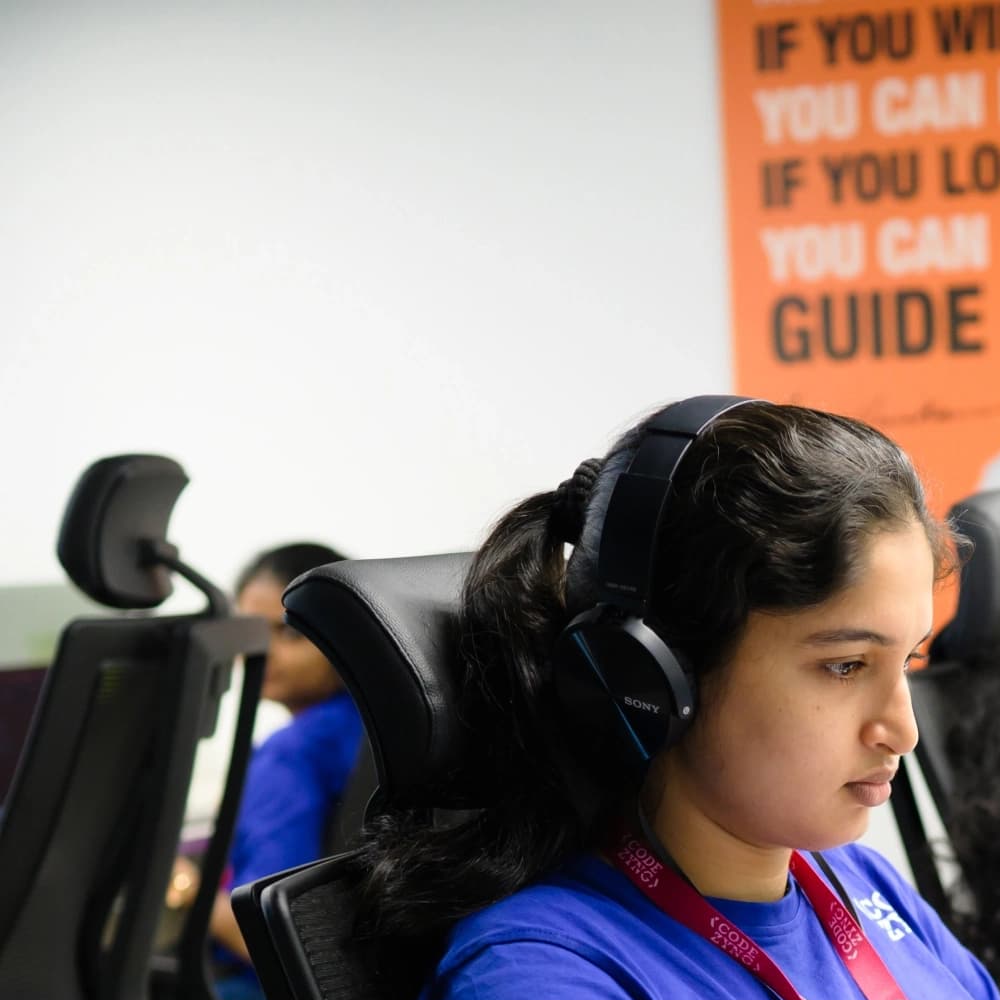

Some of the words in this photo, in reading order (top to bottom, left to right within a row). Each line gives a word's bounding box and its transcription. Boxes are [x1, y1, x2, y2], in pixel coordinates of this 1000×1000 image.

[756, 20, 799, 71] IF
[816, 13, 914, 66] YOU
[753, 81, 859, 143] YOU
[873, 71, 984, 136] CAN
[761, 159, 805, 208] IF
[821, 149, 918, 203] YOU
[761, 223, 862, 283] YOU
[878, 215, 989, 275] CAN
[771, 286, 984, 363] GUIDE
[624, 697, 660, 714] SONY
[629, 840, 663, 873] CODE
[719, 923, 759, 959] CODE
[829, 916, 853, 953] CODE
